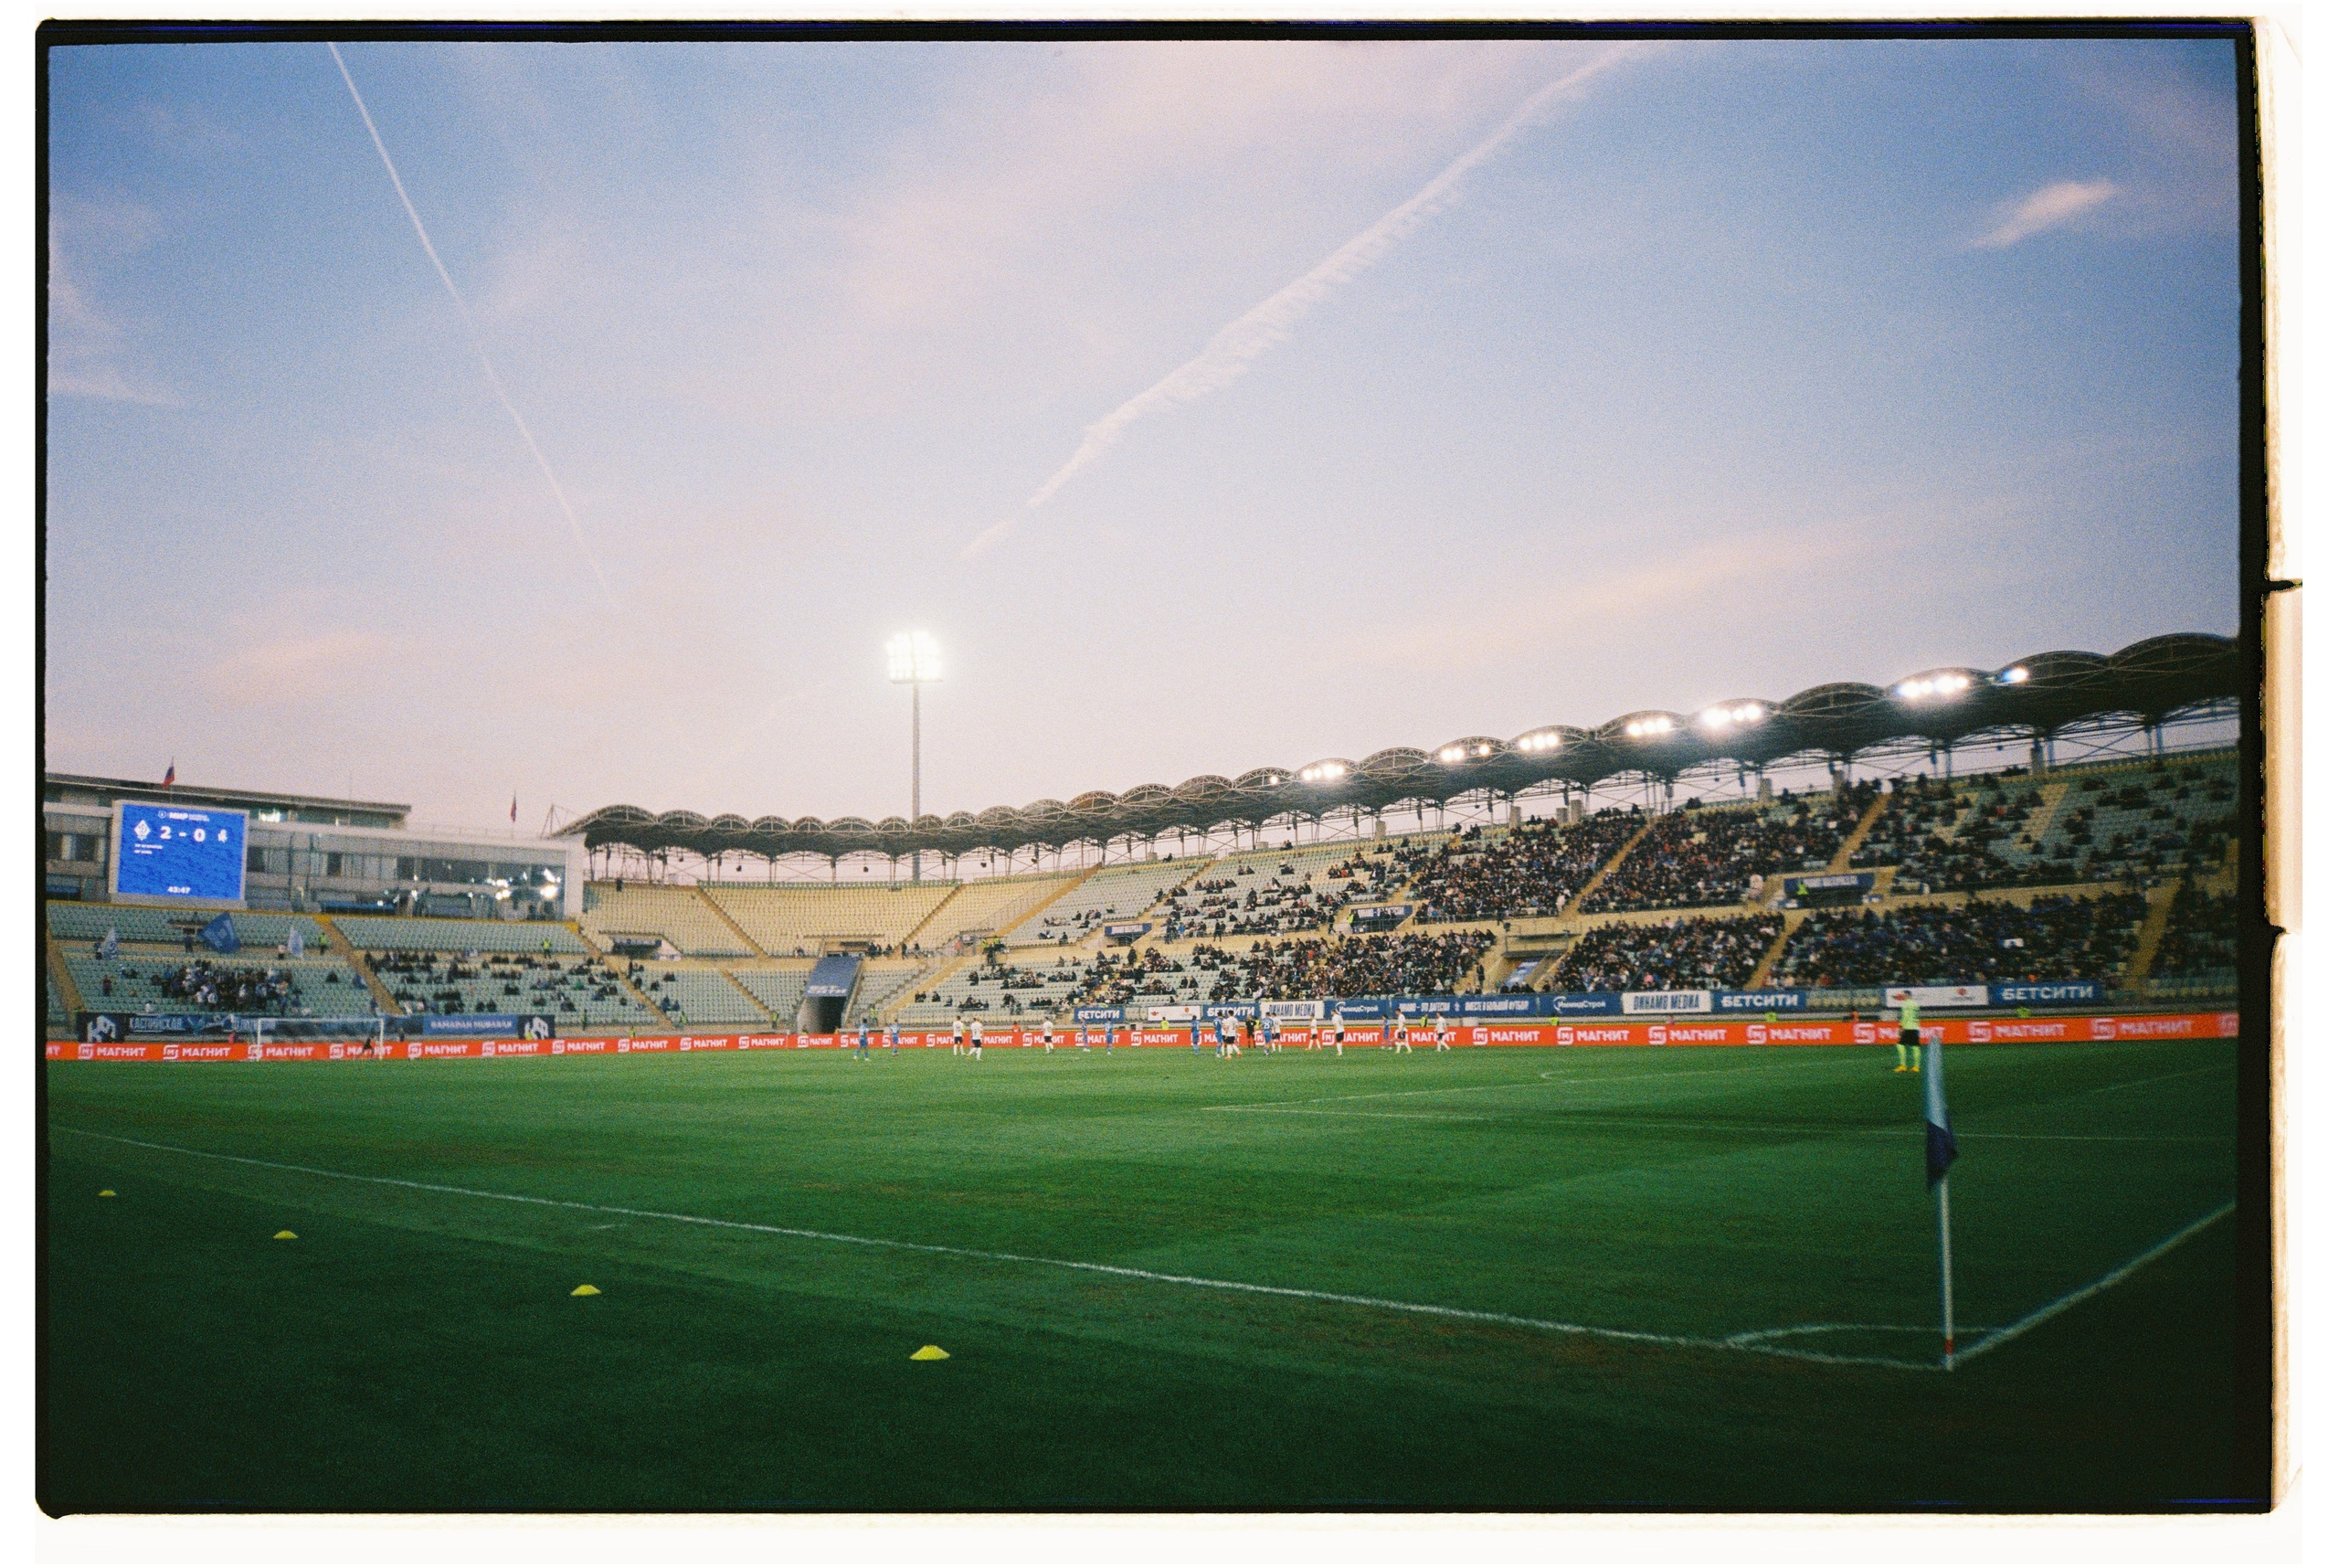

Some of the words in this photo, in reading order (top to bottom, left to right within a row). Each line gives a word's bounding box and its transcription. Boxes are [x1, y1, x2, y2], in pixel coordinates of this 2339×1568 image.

[160, 825, 172, 840] 2
[193, 828, 206, 842] 0
[2002, 986, 2094, 1001] БЕТСИТИ
[1721, 994, 1798, 1007] БЕТСИТИ
[1078, 1010, 1120, 1019] БЕТСИТИ
[984, 1035, 1013, 1044] МАГНИТ
[1144, 1033, 1179, 1043] МАГНИТ
[1491, 1031, 1540, 1042] МАГНИТ
[1576, 1030, 1630, 1042] МАГНИТ
[1669, 1029, 1727, 1042] МАГНИТ
[1769, 1028, 1833, 1041] МАГНИТ
[632, 1040, 668, 1050] МАГНИТ
[693, 1039, 728, 1048] МАГНИТ
[751, 1038, 785, 1047] МАГНИТ
[810, 1037, 833, 1045] МАГНИТ
[97, 1047, 146, 1056] МАГНИТ
[182, 1047, 231, 1056] МАГНИТ
[266, 1046, 315, 1056] МАГНИТ
[425, 1044, 468, 1054] МАГНИТ
[498, 1044, 539, 1054] МАГНИТ
[566, 1042, 605, 1051] МАГНИТ
